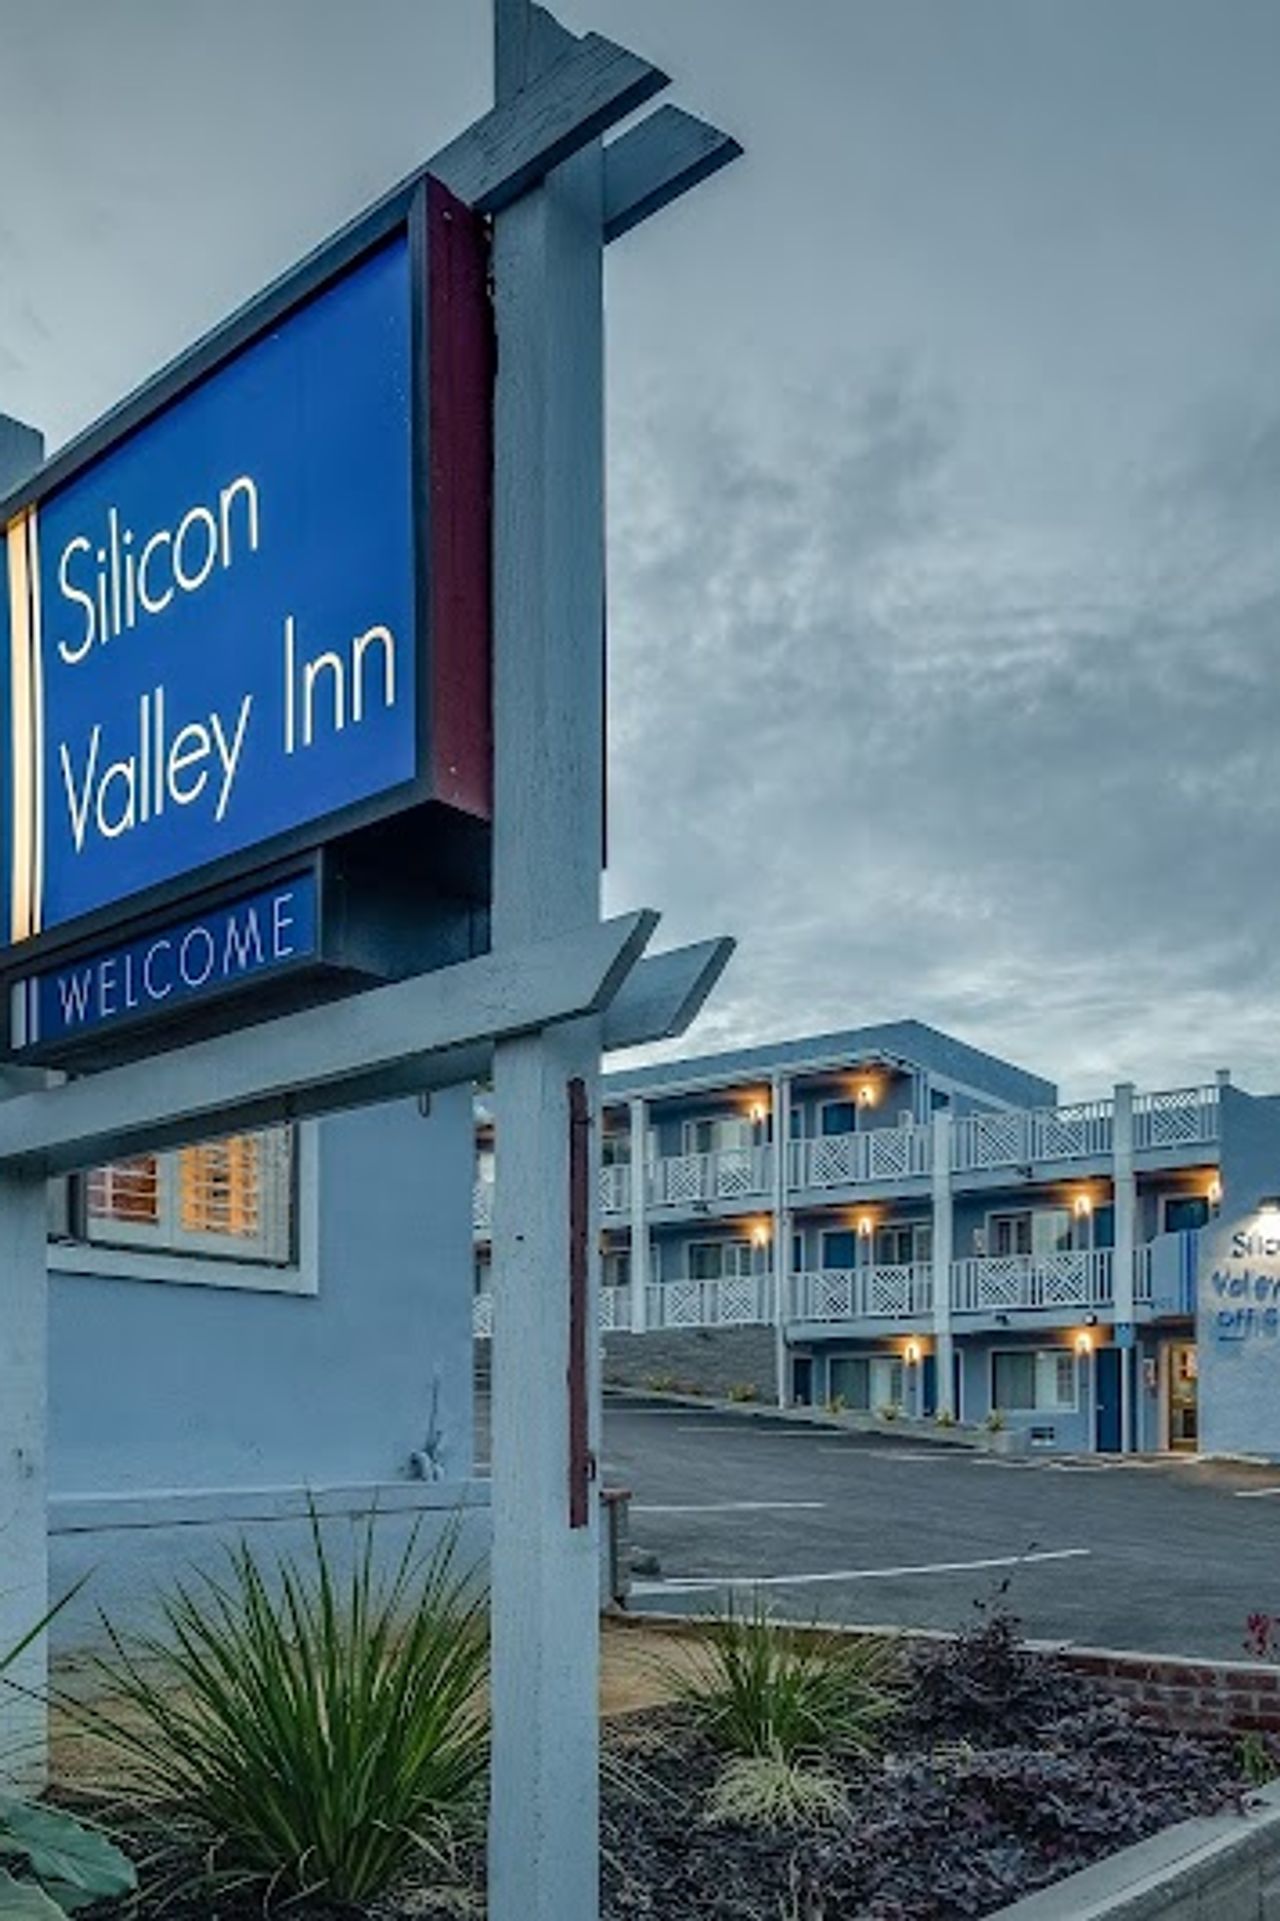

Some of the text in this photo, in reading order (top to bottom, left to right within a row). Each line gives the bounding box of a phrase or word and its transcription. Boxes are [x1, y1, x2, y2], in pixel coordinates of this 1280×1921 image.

[58, 476, 259, 664] Silicon
[60, 616, 395, 853] Valley Inn
[57, 893, 295, 1025] WELCOME
